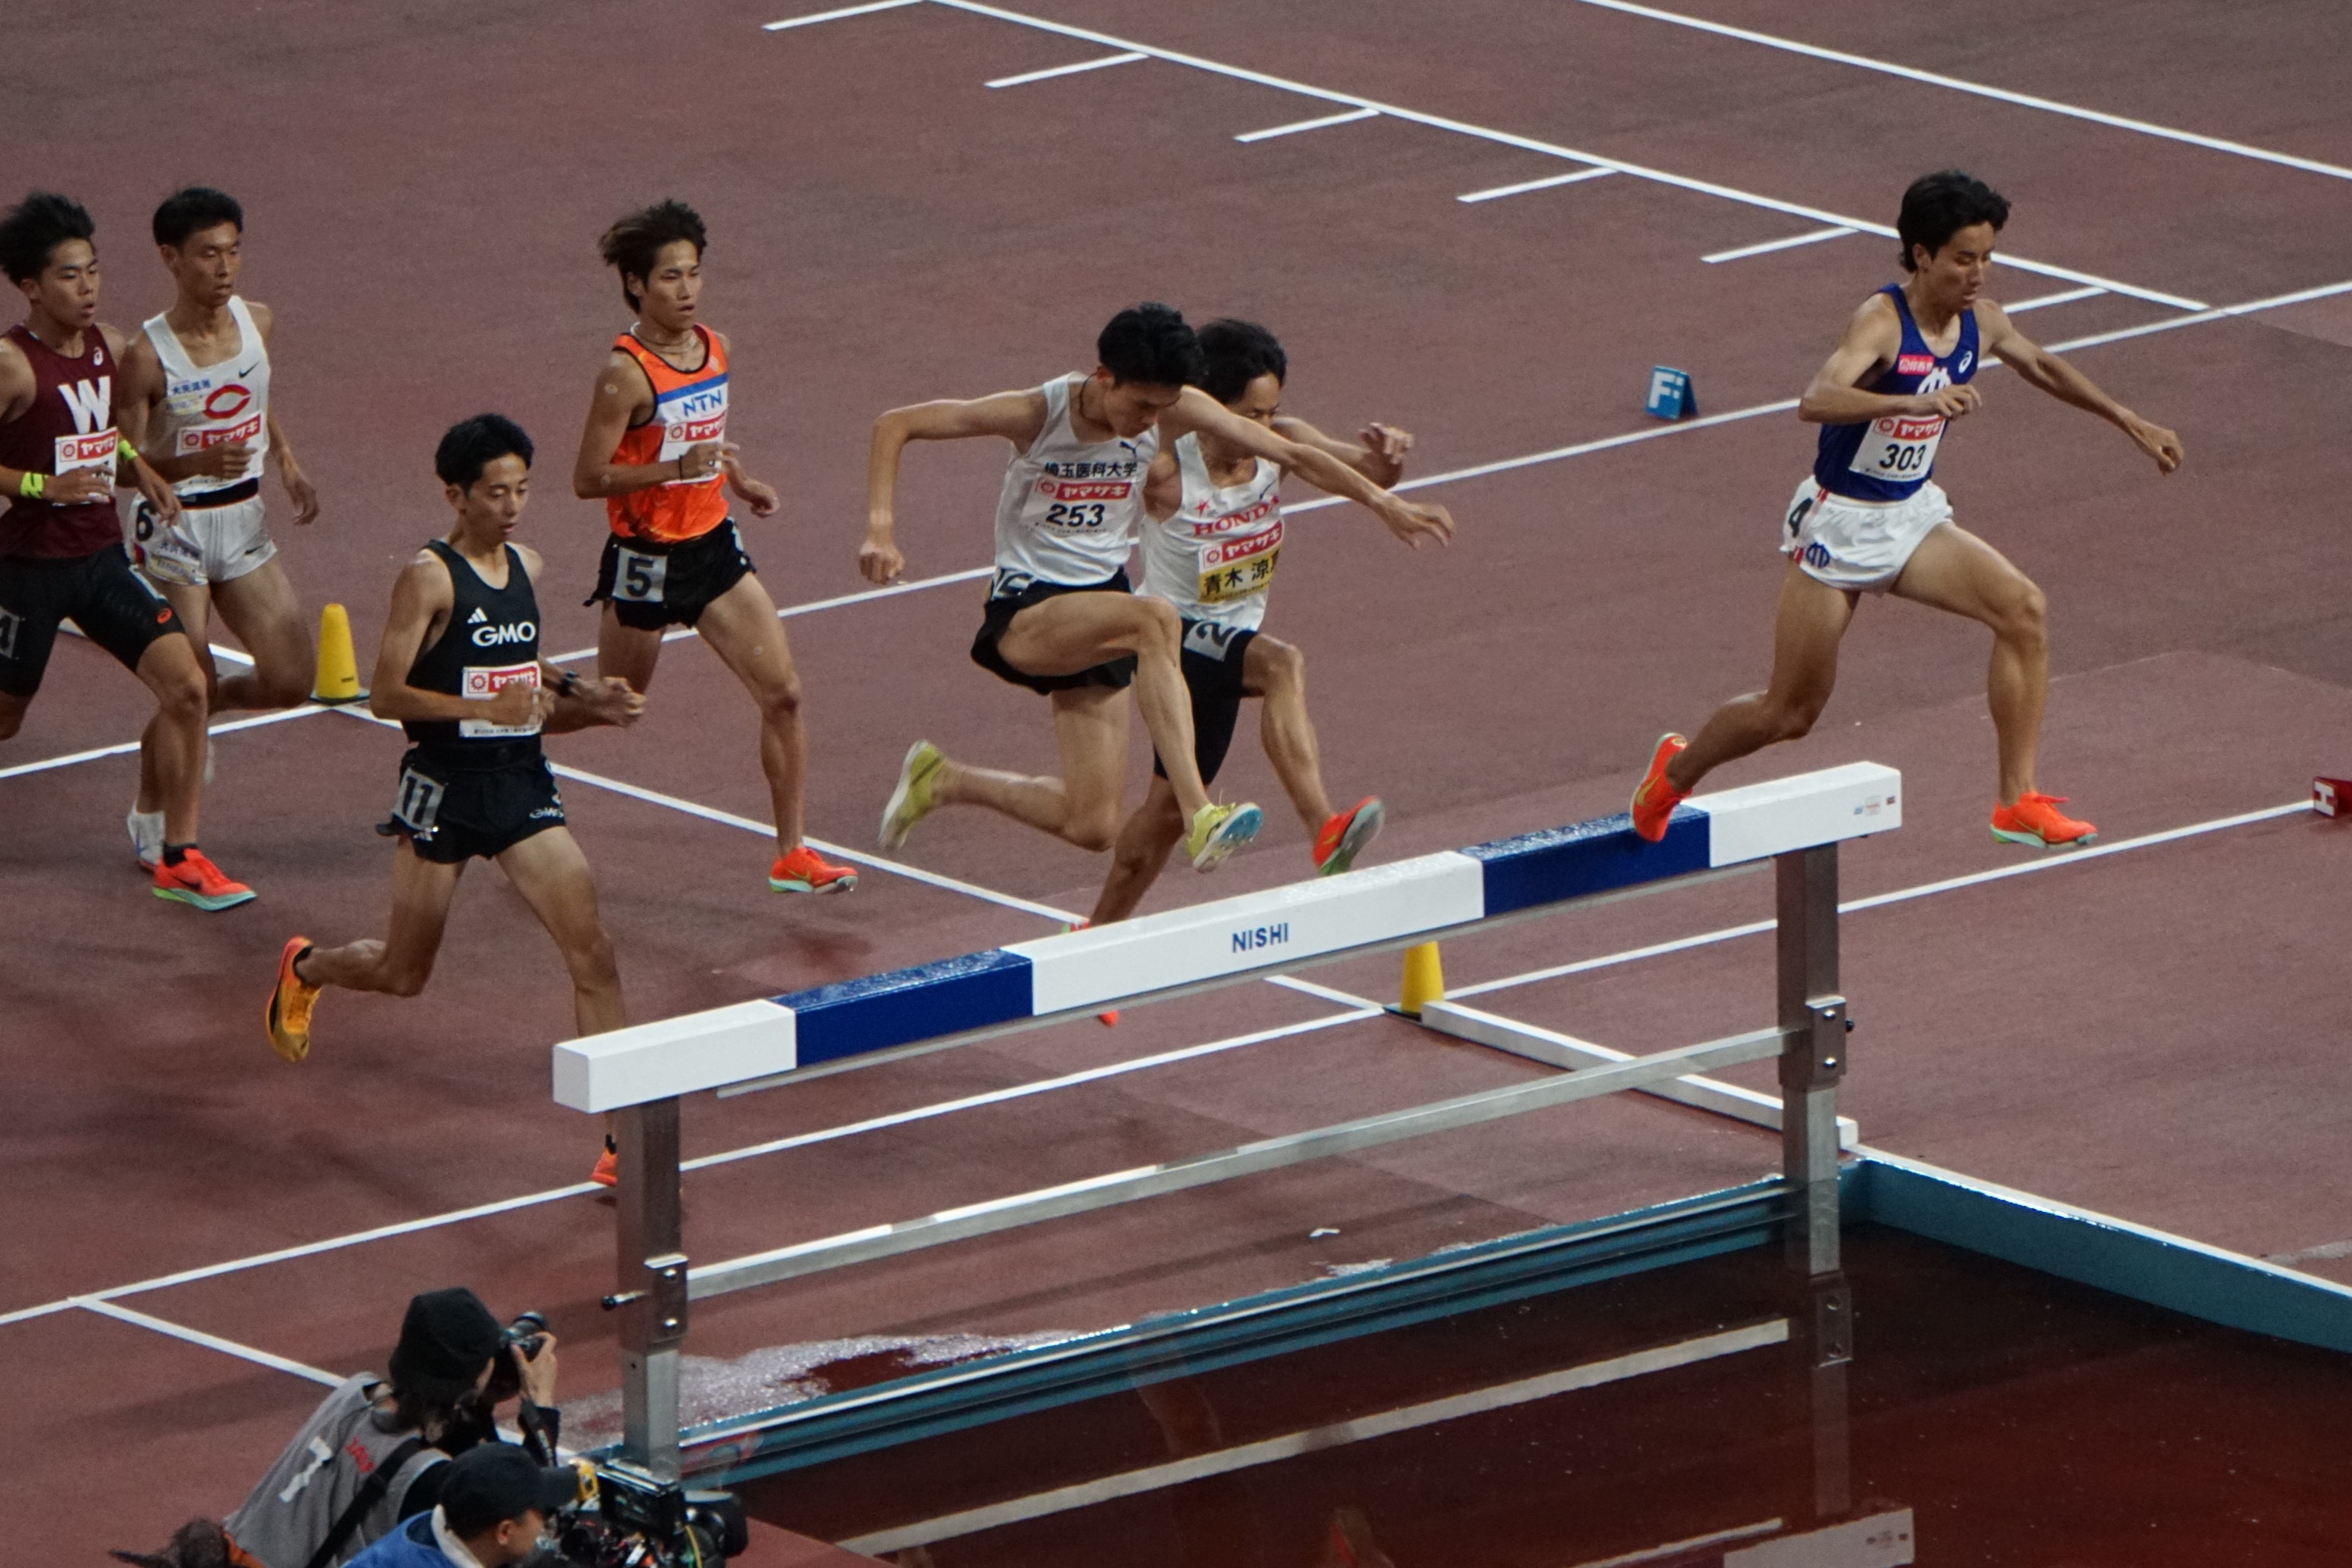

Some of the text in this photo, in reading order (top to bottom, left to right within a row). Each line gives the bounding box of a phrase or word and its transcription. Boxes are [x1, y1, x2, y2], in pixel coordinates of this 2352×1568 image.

[58, 376, 110, 434] W
[683, 389, 723, 418] NTN
[1045, 462, 1138, 478] 埼玉医科大学
[1879, 443, 1927, 471] 303
[136, 501, 158, 542] 6
[1045, 503, 1106, 527] 253
[626, 557, 653, 596] 5
[472, 621, 536, 647] GMO
[402, 776, 434, 825] 11
[1233, 922, 1288, 953] NISHI
